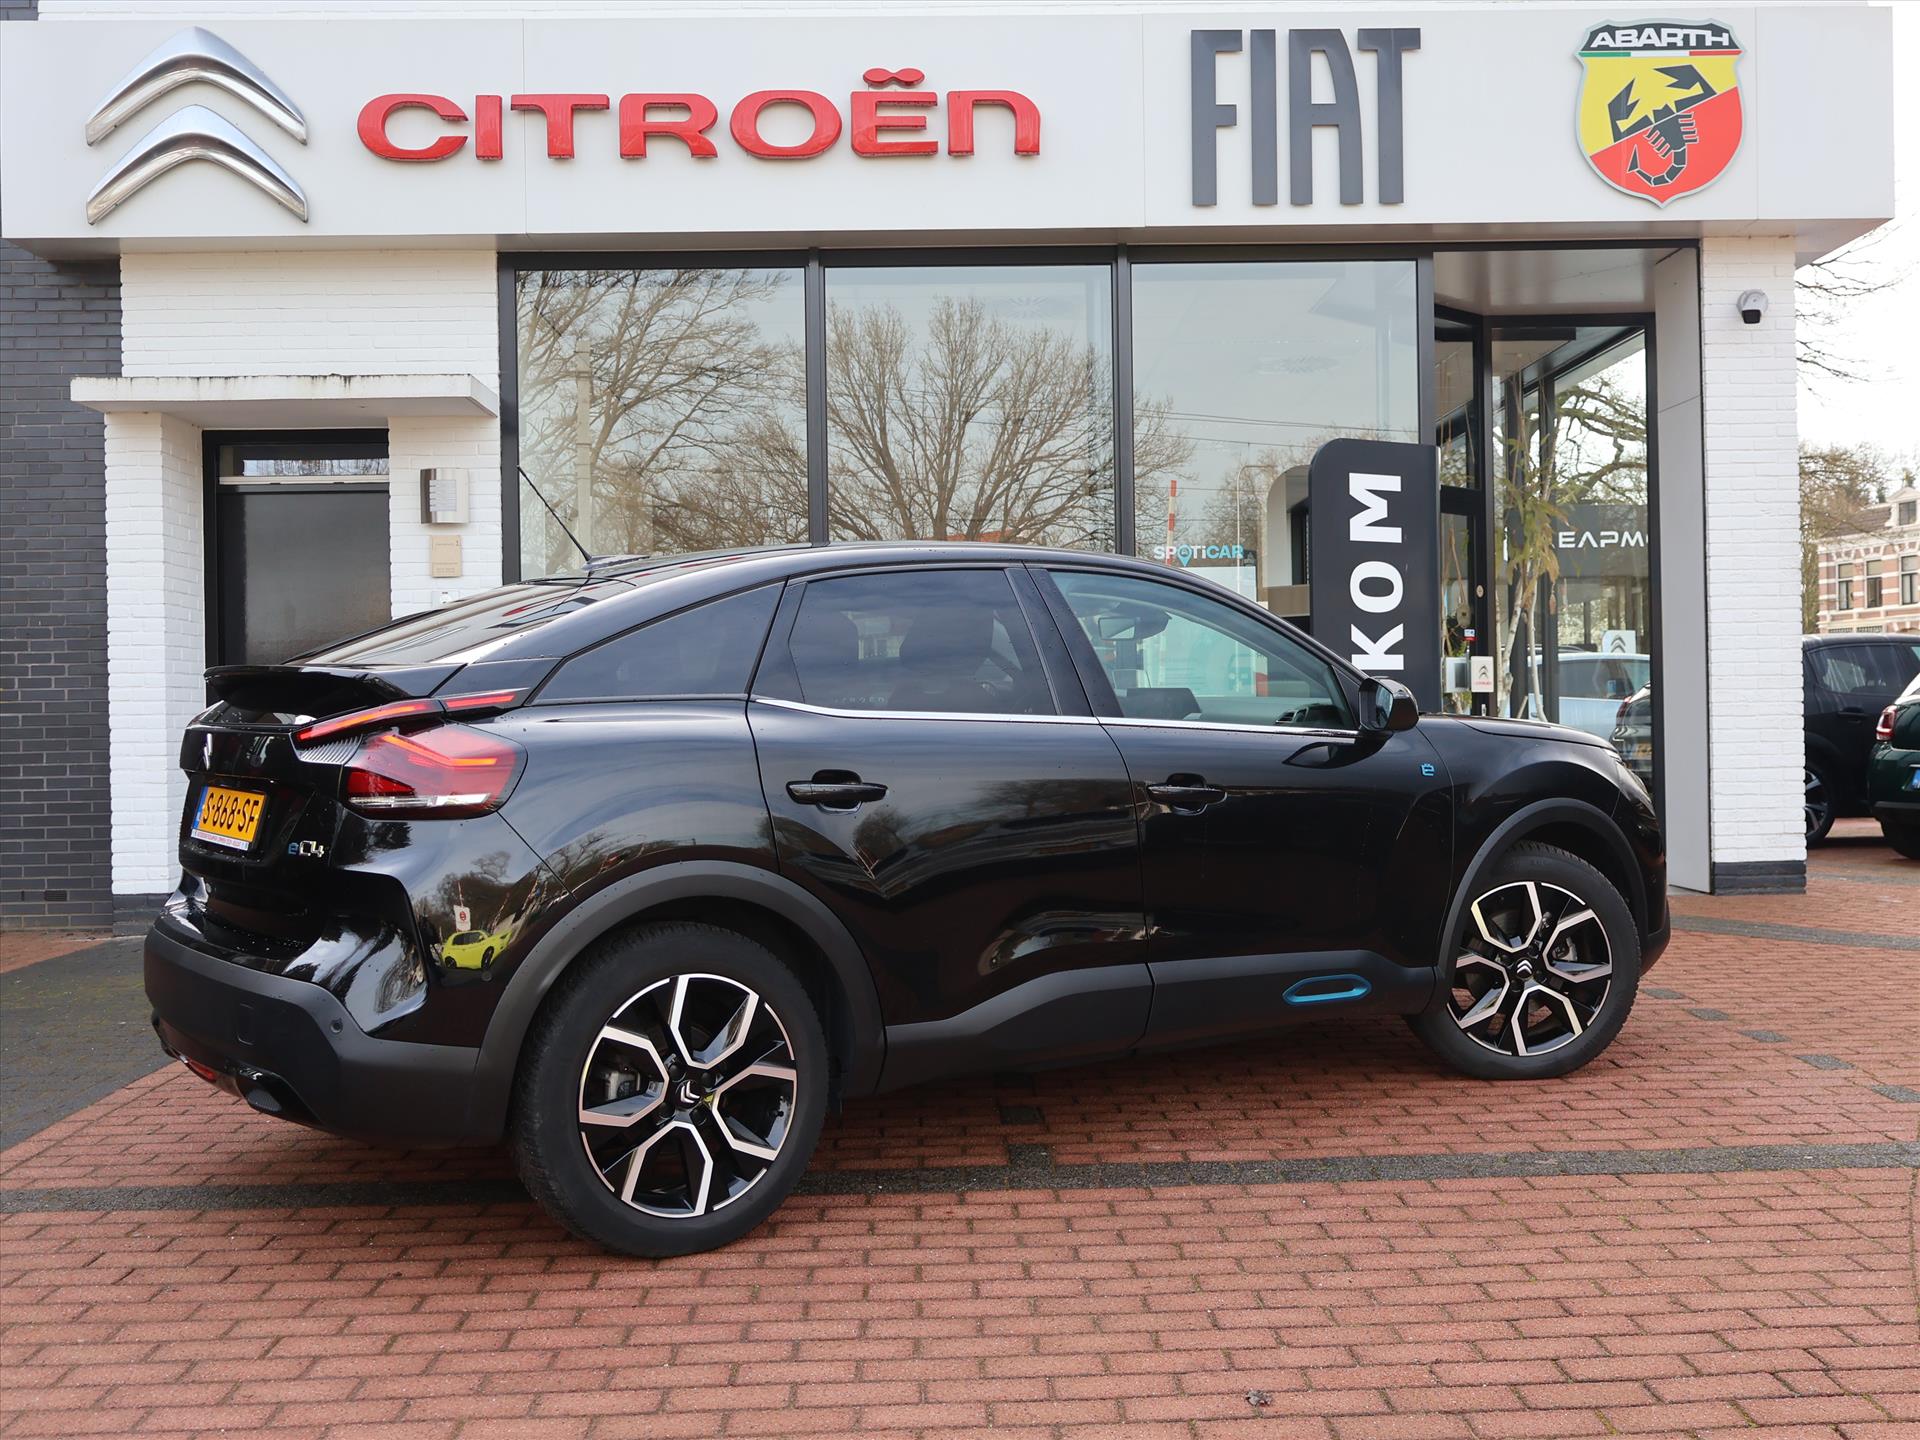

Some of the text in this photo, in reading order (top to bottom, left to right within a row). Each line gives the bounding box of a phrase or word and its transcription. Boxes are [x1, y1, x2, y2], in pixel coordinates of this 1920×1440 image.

[1590, 28, 1730, 49] ABARTH
[1191, 28, 1420, 206] FIAT
[1552, 530, 1649, 549] EAPM
[1349, 472, 1404, 671] KOM
[202, 792, 260, 833] S-868-SF
